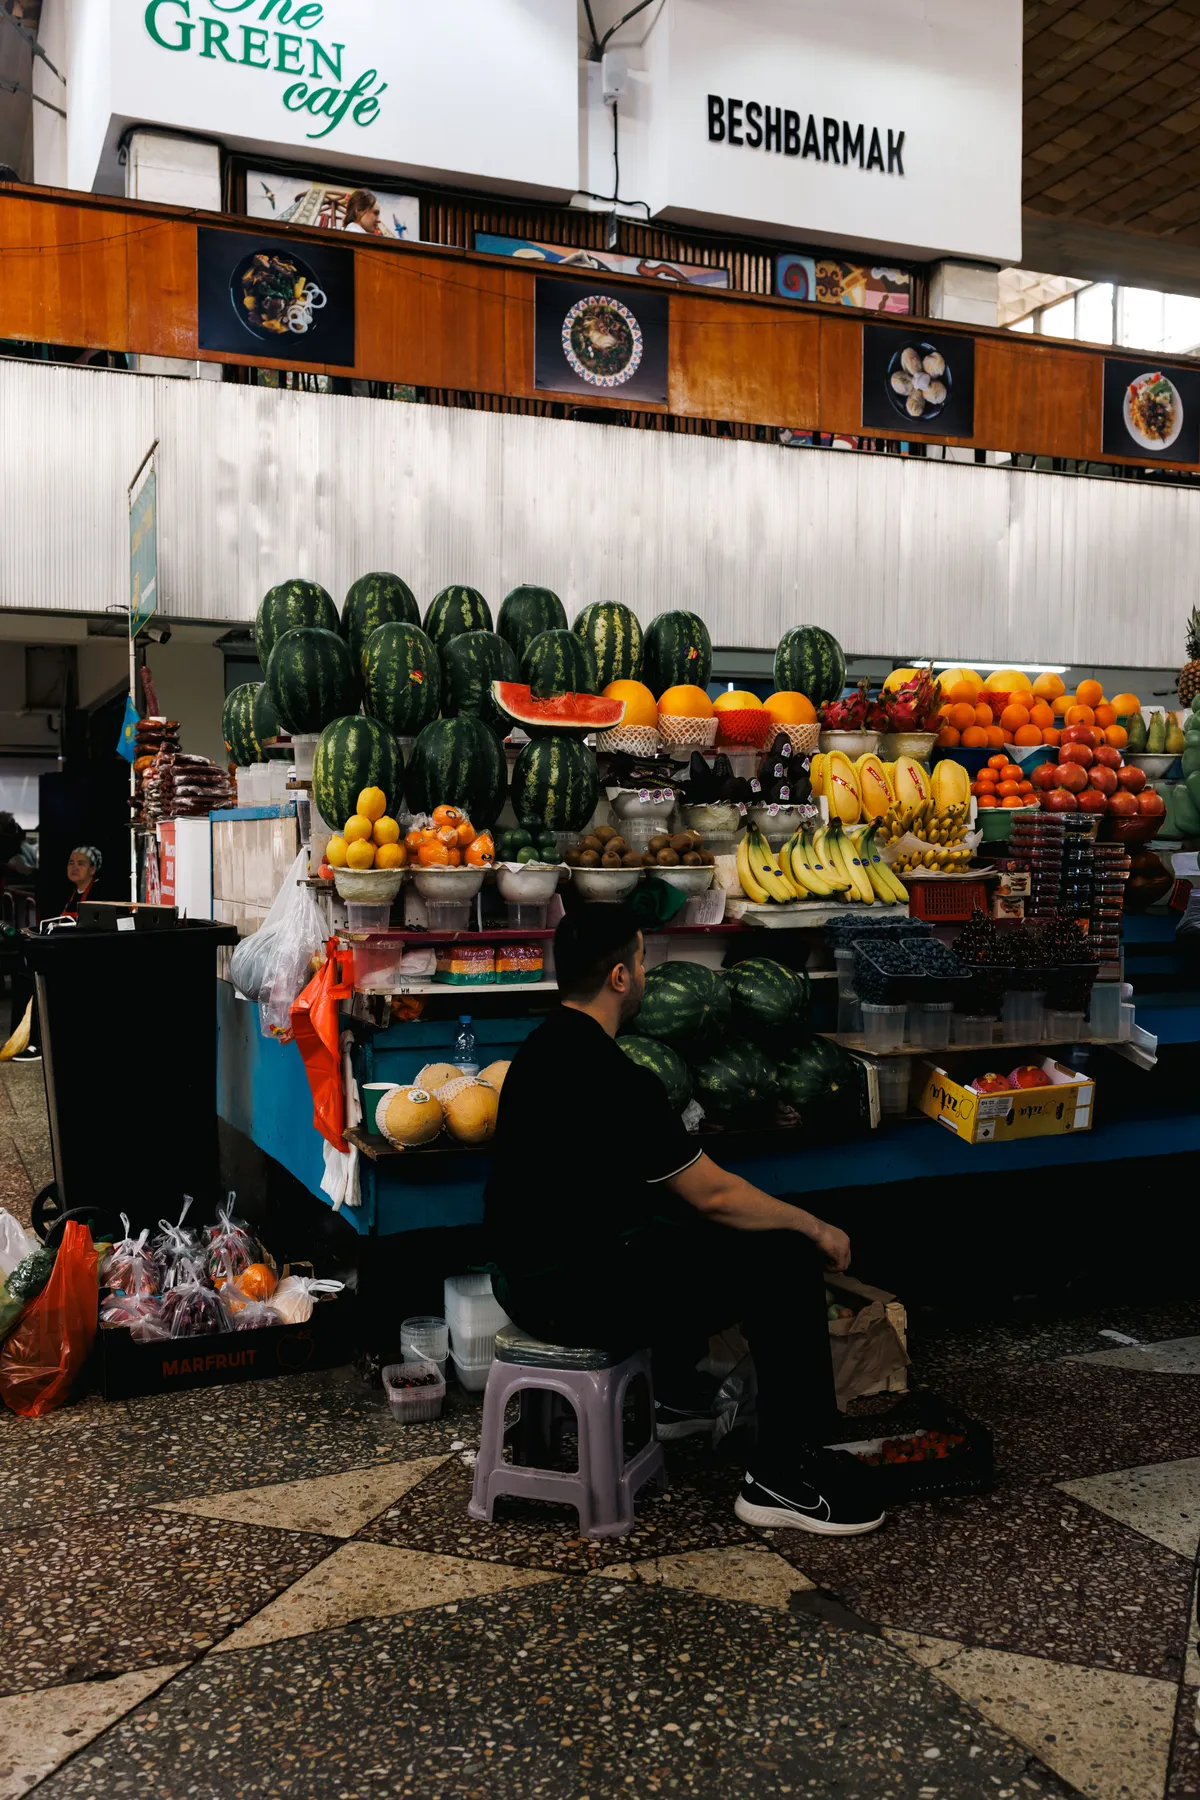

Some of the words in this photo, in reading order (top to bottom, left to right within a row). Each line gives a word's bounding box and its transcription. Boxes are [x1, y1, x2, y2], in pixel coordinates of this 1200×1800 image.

[144, 0, 346, 82] GREEN
[282, 68, 389, 139] café
[707, 93, 906, 176] BESHBARMAK
[162, 1349, 257, 1378] MARFRUIT
